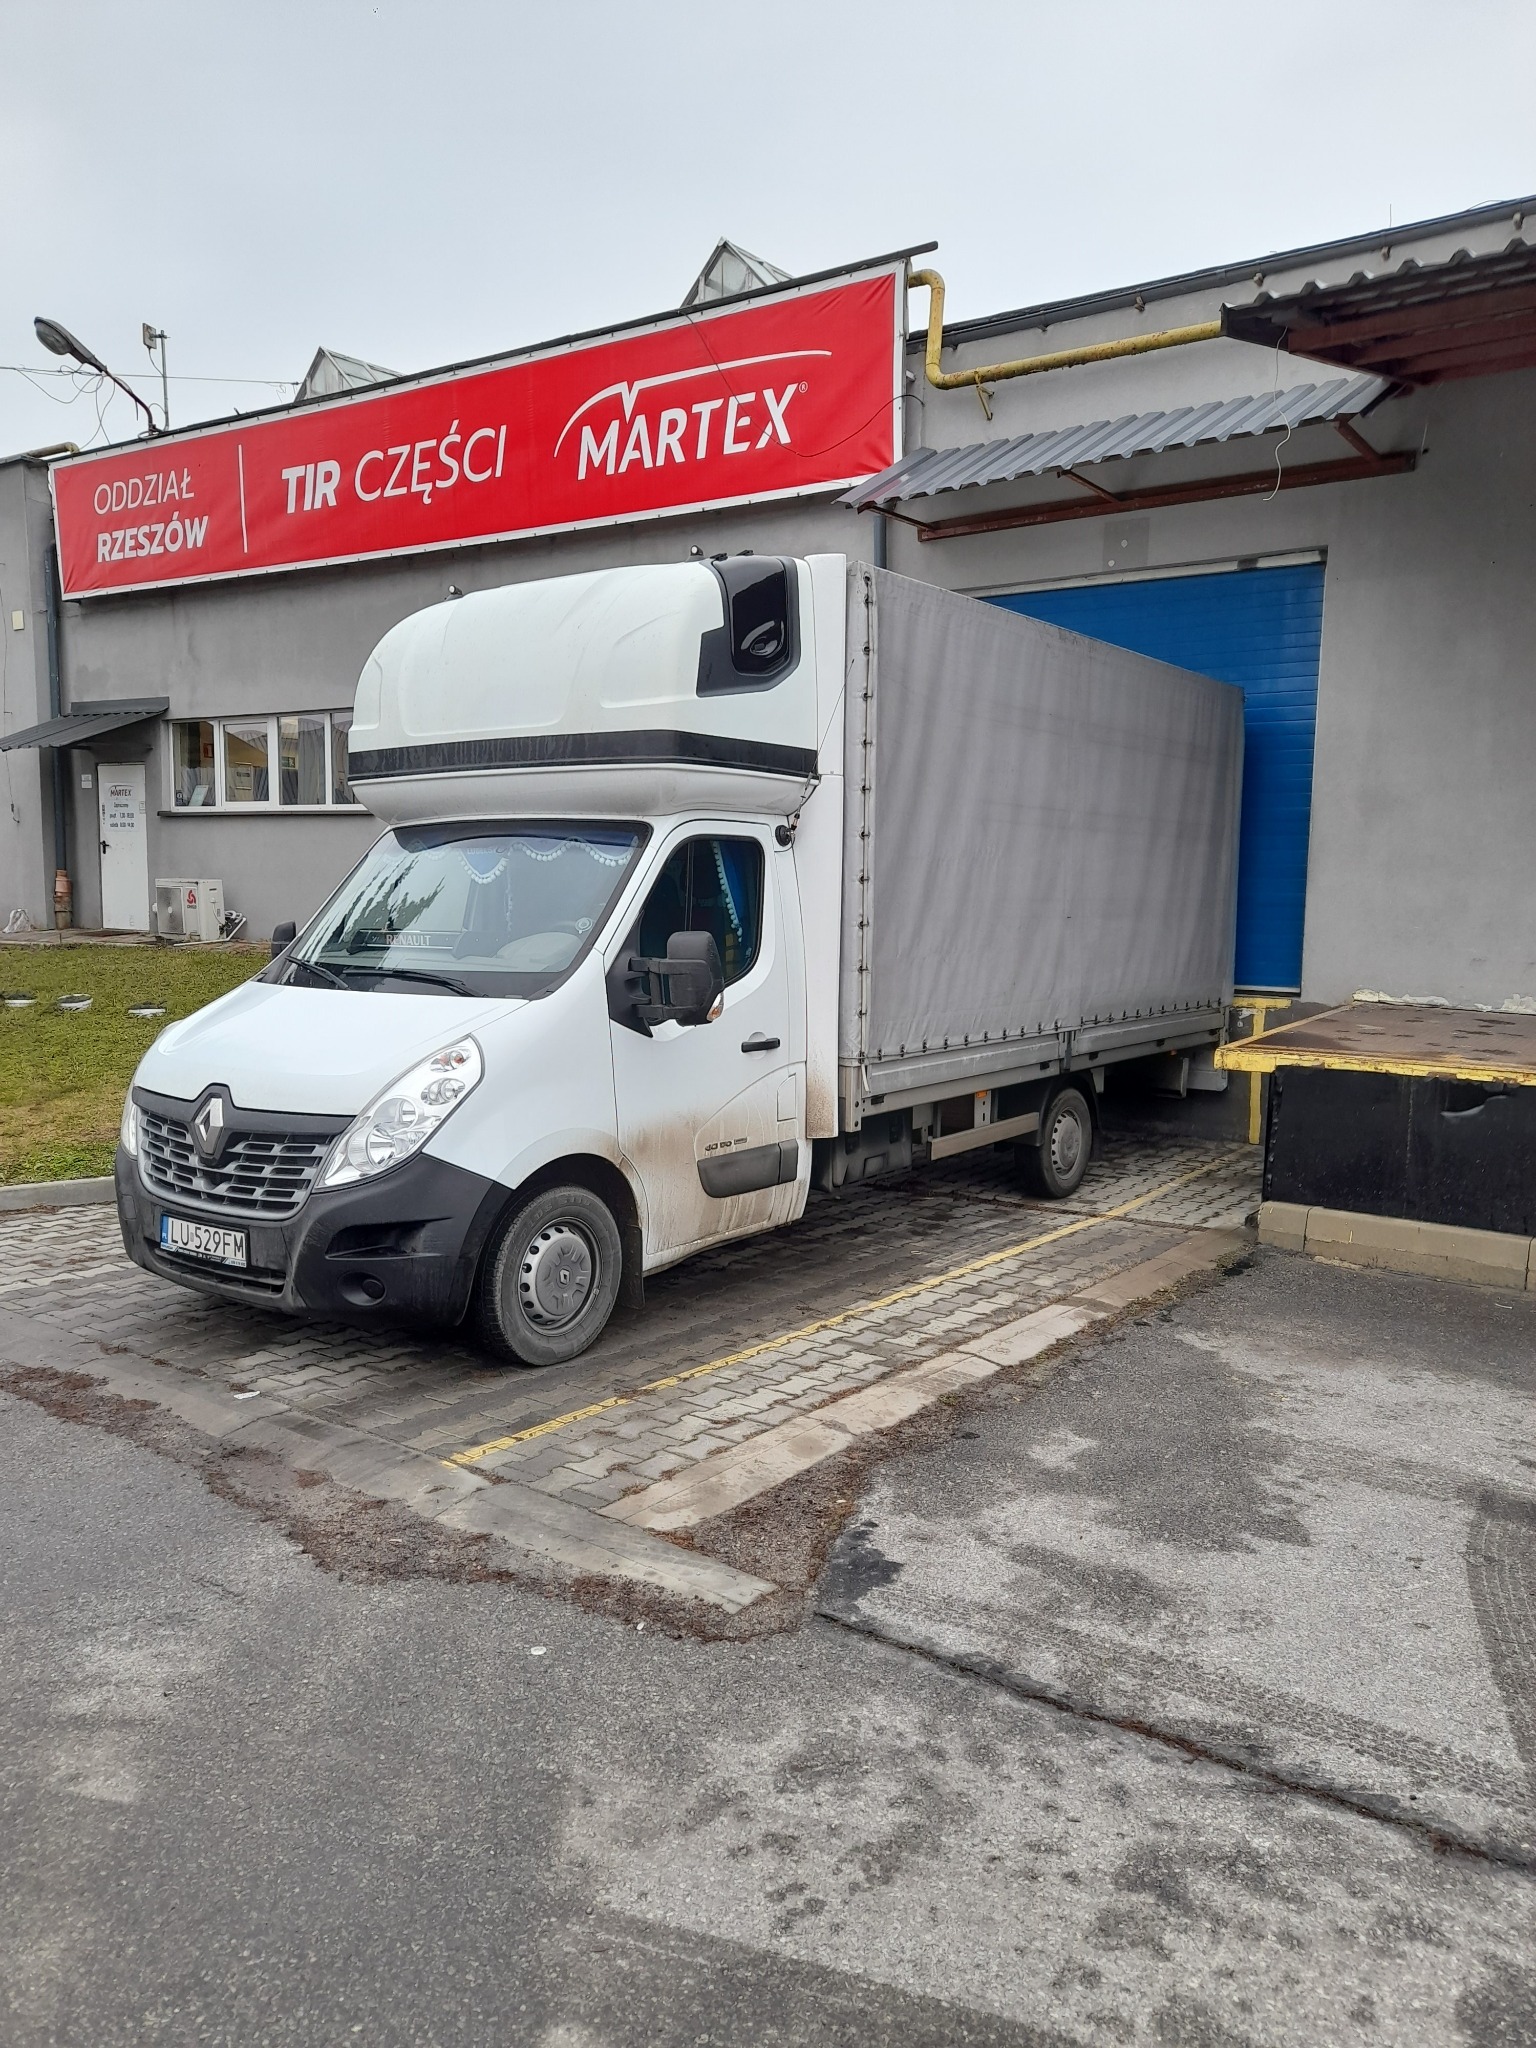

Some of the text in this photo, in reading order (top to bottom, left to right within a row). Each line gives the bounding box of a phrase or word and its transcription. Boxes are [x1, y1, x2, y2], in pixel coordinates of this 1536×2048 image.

[281, 419, 507, 514] TIR CZĘŚCI
[94, 467, 195, 515] ODDZIAŁ
[97, 512, 208, 563] RZESZÓW
[110, 788, 132, 797] MARTEX
[386, 934, 432, 946] RENAULT
